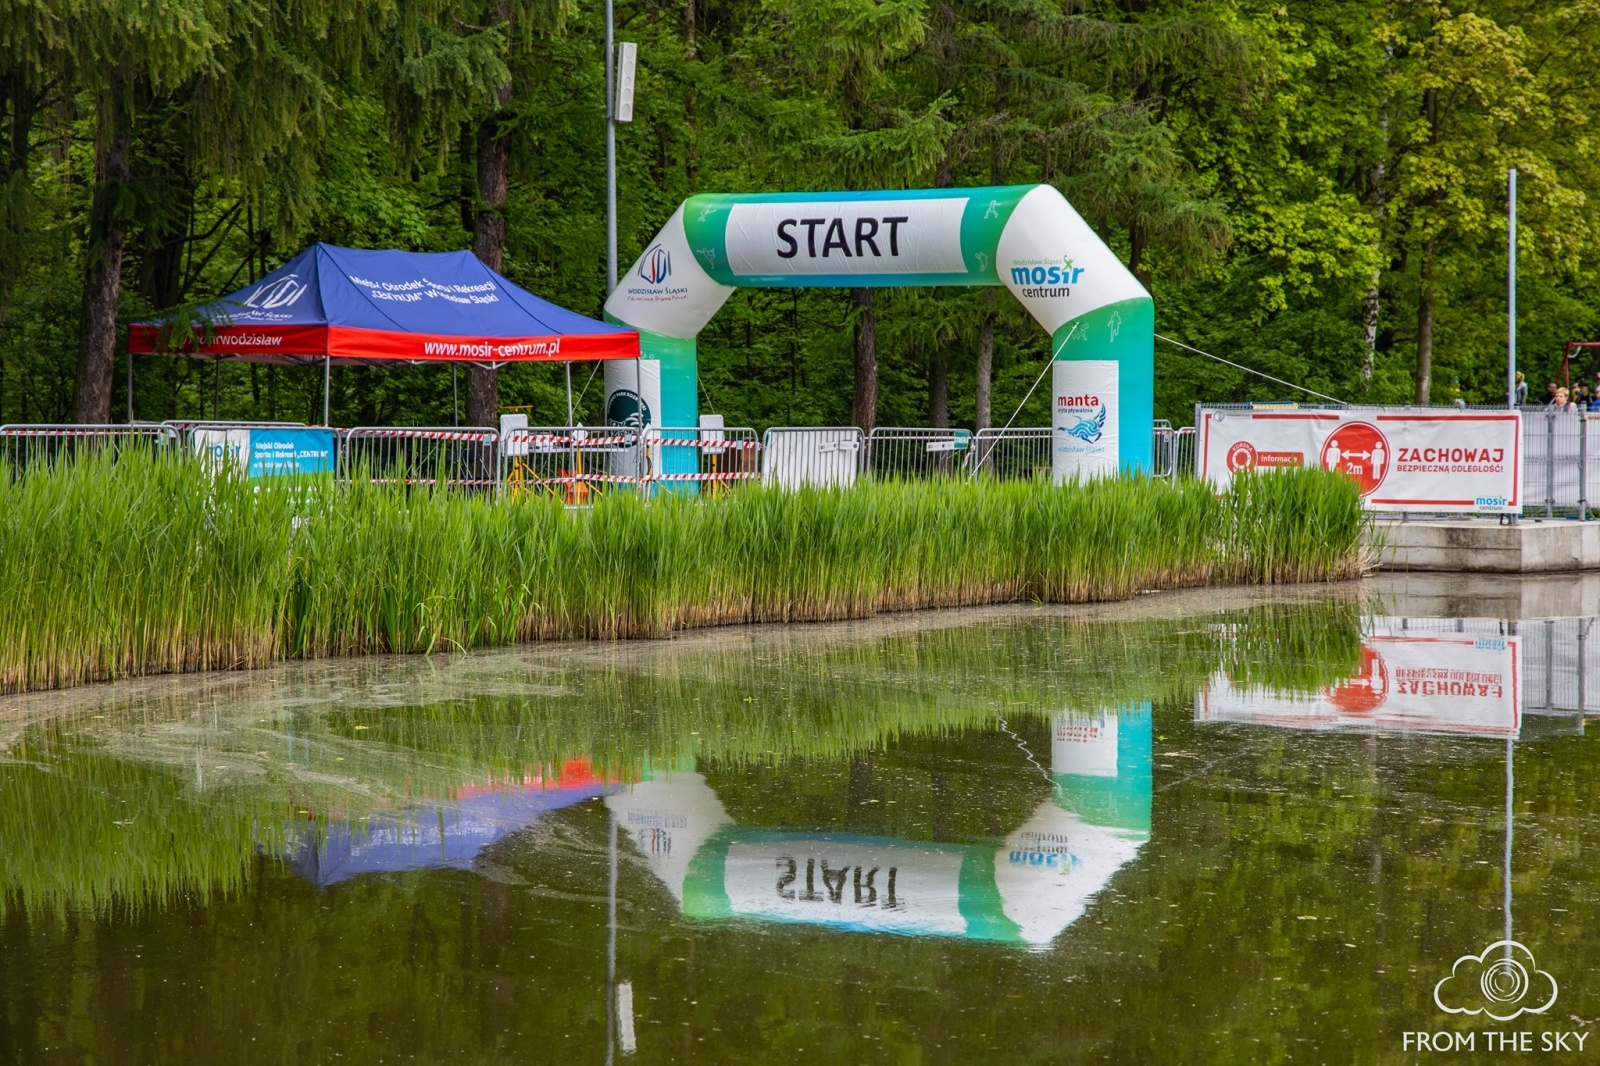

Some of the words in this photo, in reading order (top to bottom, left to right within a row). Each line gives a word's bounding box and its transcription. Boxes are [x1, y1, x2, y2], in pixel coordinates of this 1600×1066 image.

[777, 216, 909, 259] START
[1010, 265, 1085, 286] mosir
[381, 279, 425, 292] Ośrodek
[455, 280, 497, 295] Rekreacji
[1022, 285, 1070, 298] centrum
[424, 337, 561, 358] www.mosir-centrum.pl
[1057, 394, 1099, 406] manta
[1232, 443, 1253, 453] KORONA
[1260, 454, 1298, 463] informace
[1397, 448, 1504, 463] ZACHOWAJ
[1346, 462, 1363, 475] 2m
[1396, 464, 1450, 475] BEZPIECZNĄ
[1451, 463, 1504, 473] ODLEGŁOŚĆ!
[1475, 496, 1507, 506] mosir
